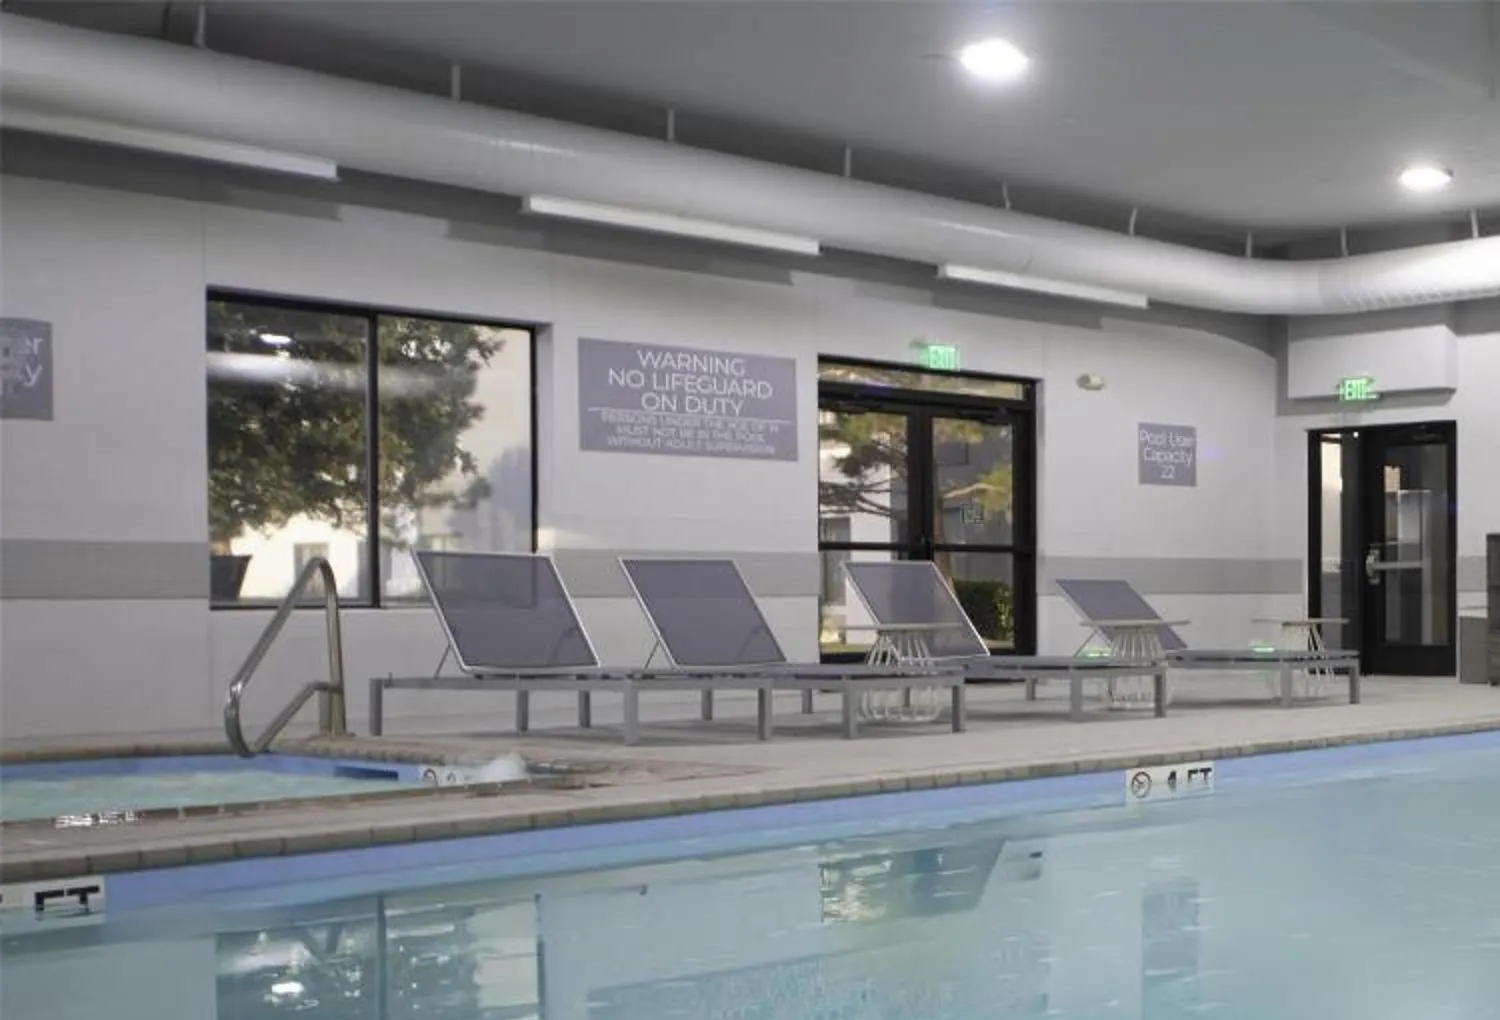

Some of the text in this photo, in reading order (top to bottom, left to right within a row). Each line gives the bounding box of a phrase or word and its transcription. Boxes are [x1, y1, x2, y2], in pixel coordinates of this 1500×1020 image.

[637, 349, 747, 377] WARNING
[928, 345, 957, 369] EXIT
[608, 367, 774, 399] NO LIFEGUARD
[640, 392, 744, 417] ON DUTY
